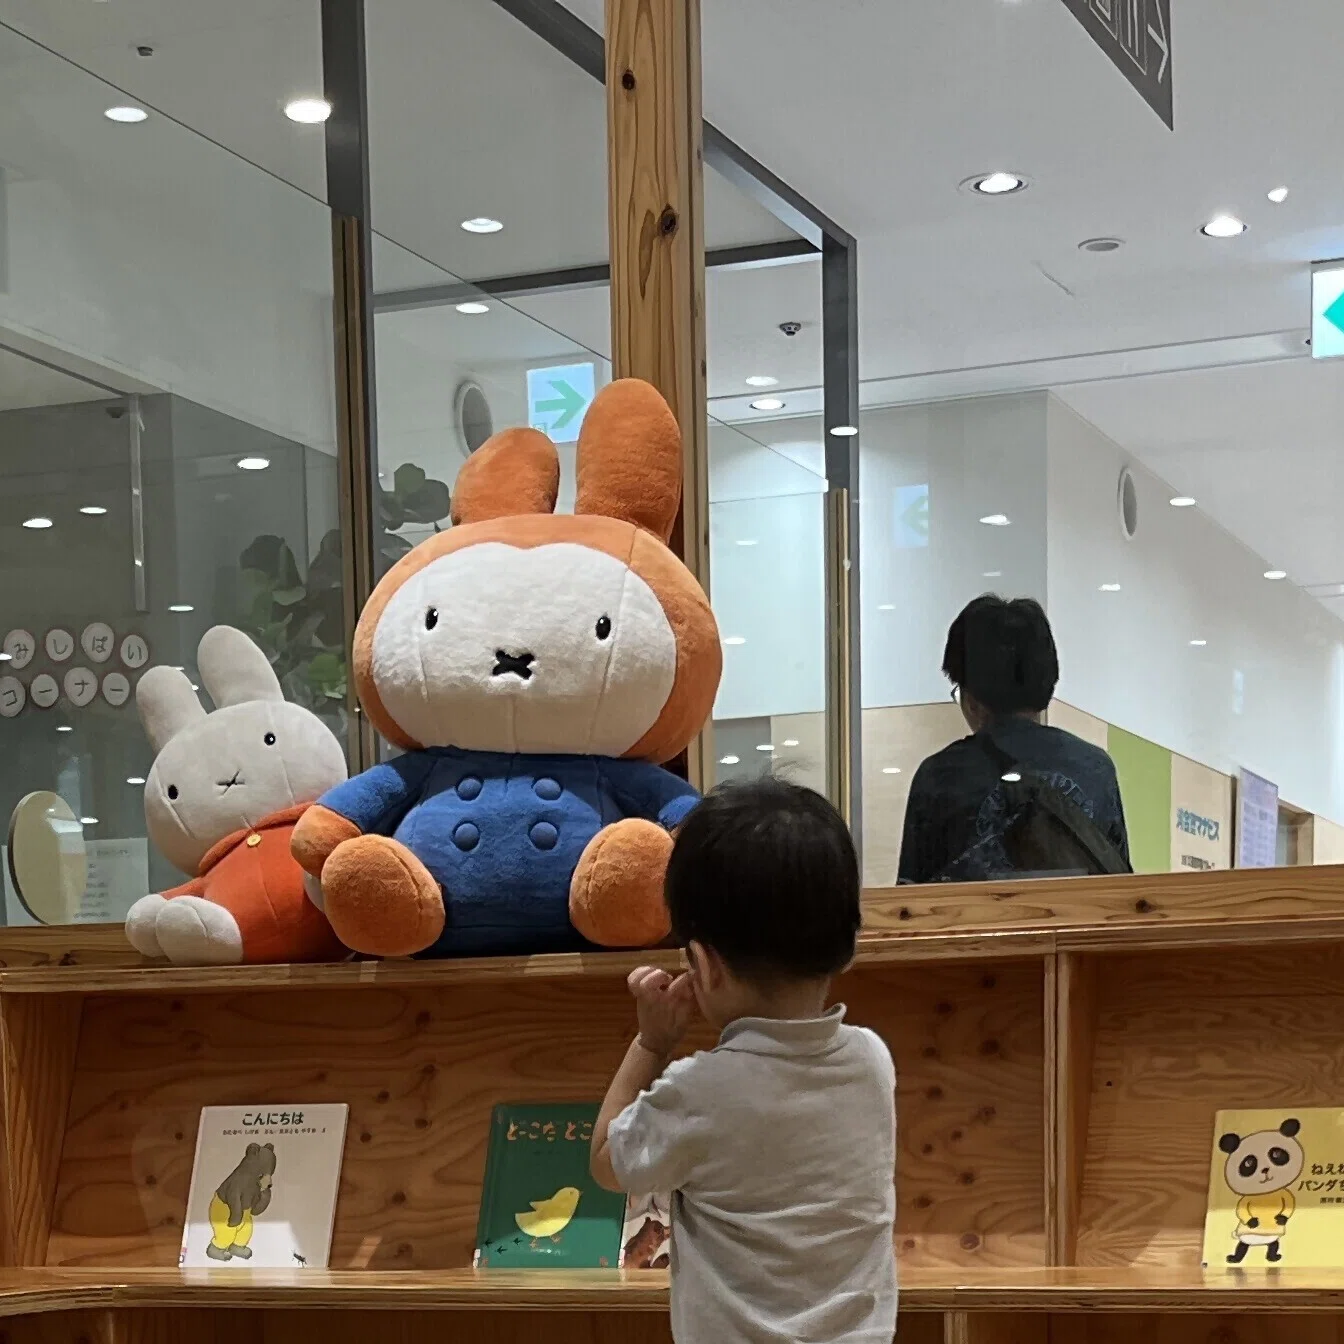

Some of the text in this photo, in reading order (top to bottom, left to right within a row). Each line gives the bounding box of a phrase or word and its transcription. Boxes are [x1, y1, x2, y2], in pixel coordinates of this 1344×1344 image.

[2, 679, 124, 707] コーナー
[242, 1111, 304, 1126] こんにちは
